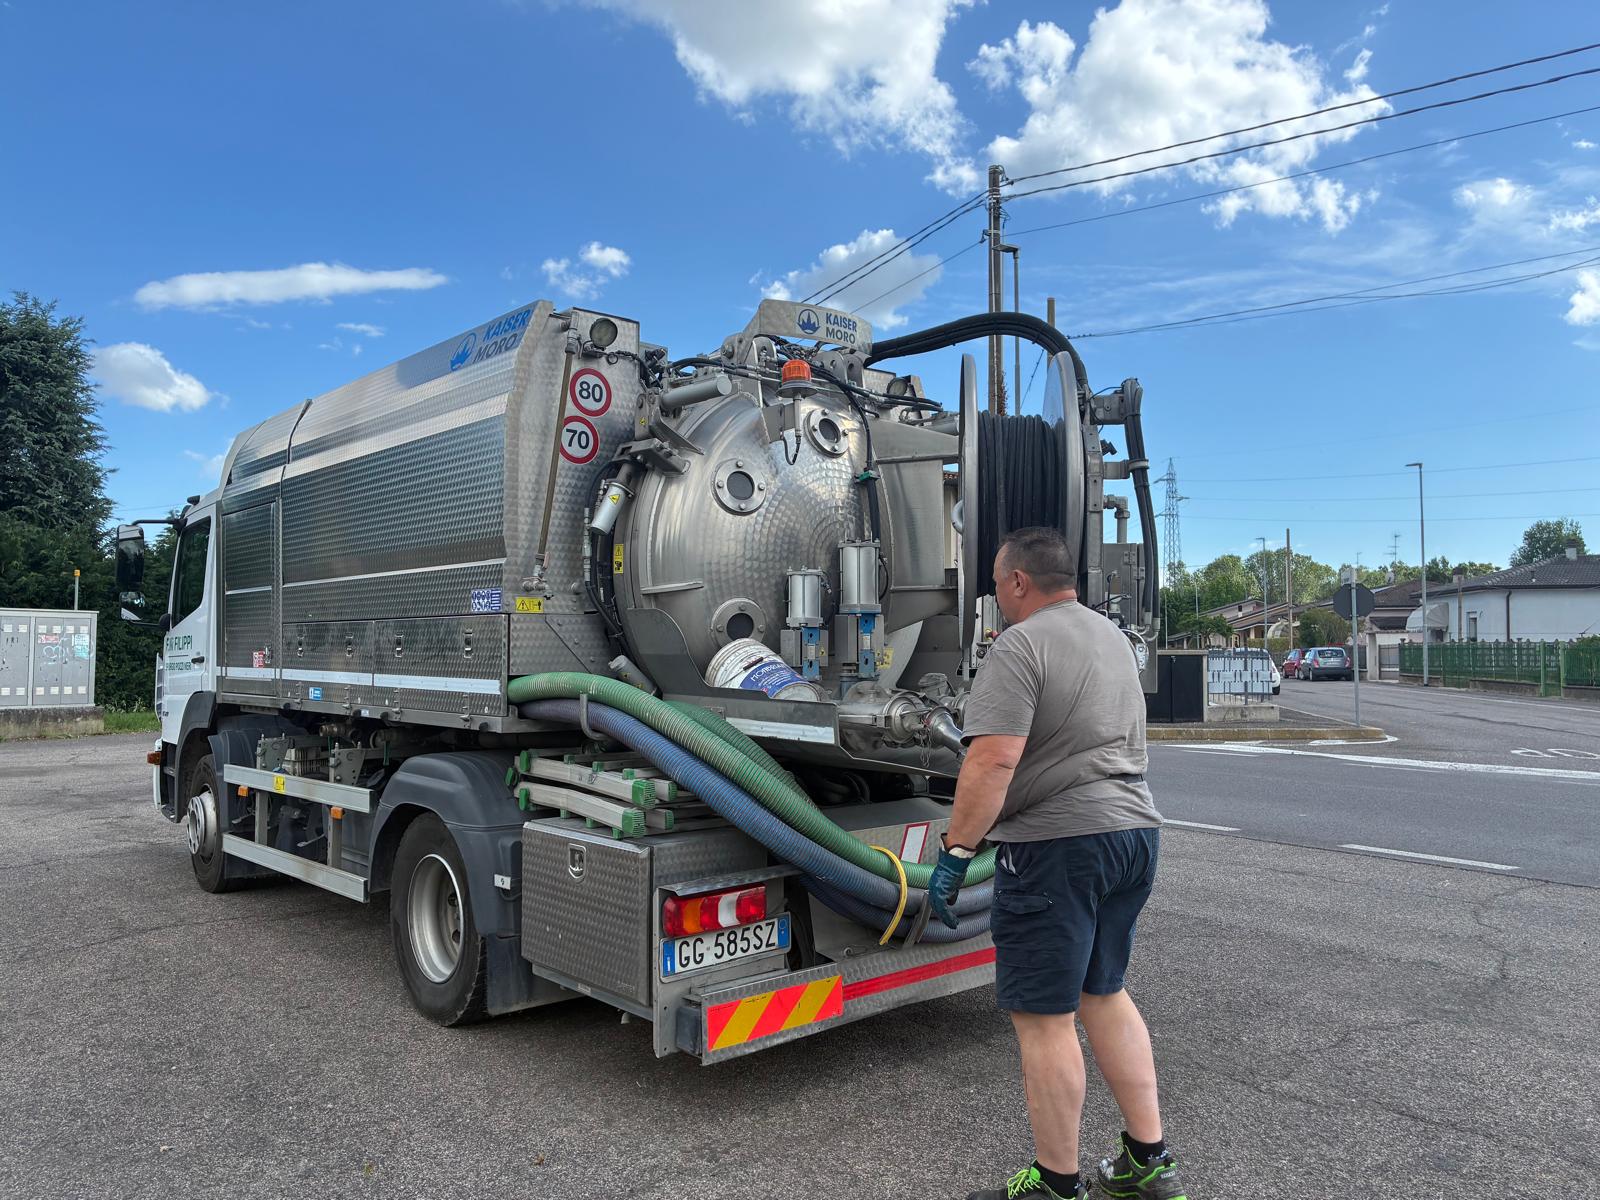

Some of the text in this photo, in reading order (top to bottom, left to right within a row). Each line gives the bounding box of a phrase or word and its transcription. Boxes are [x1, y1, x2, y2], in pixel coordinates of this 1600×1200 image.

[484, 309, 531, 342] KAISER
[826, 312, 857, 332] KAISER
[825, 327, 856, 344] MORO
[473, 333, 518, 364] MORO
[578, 381, 603, 403] 80
[565, 428, 590, 450] 70
[679, 937, 704, 968] GG
[714, 921, 776, 960] 585SZ
